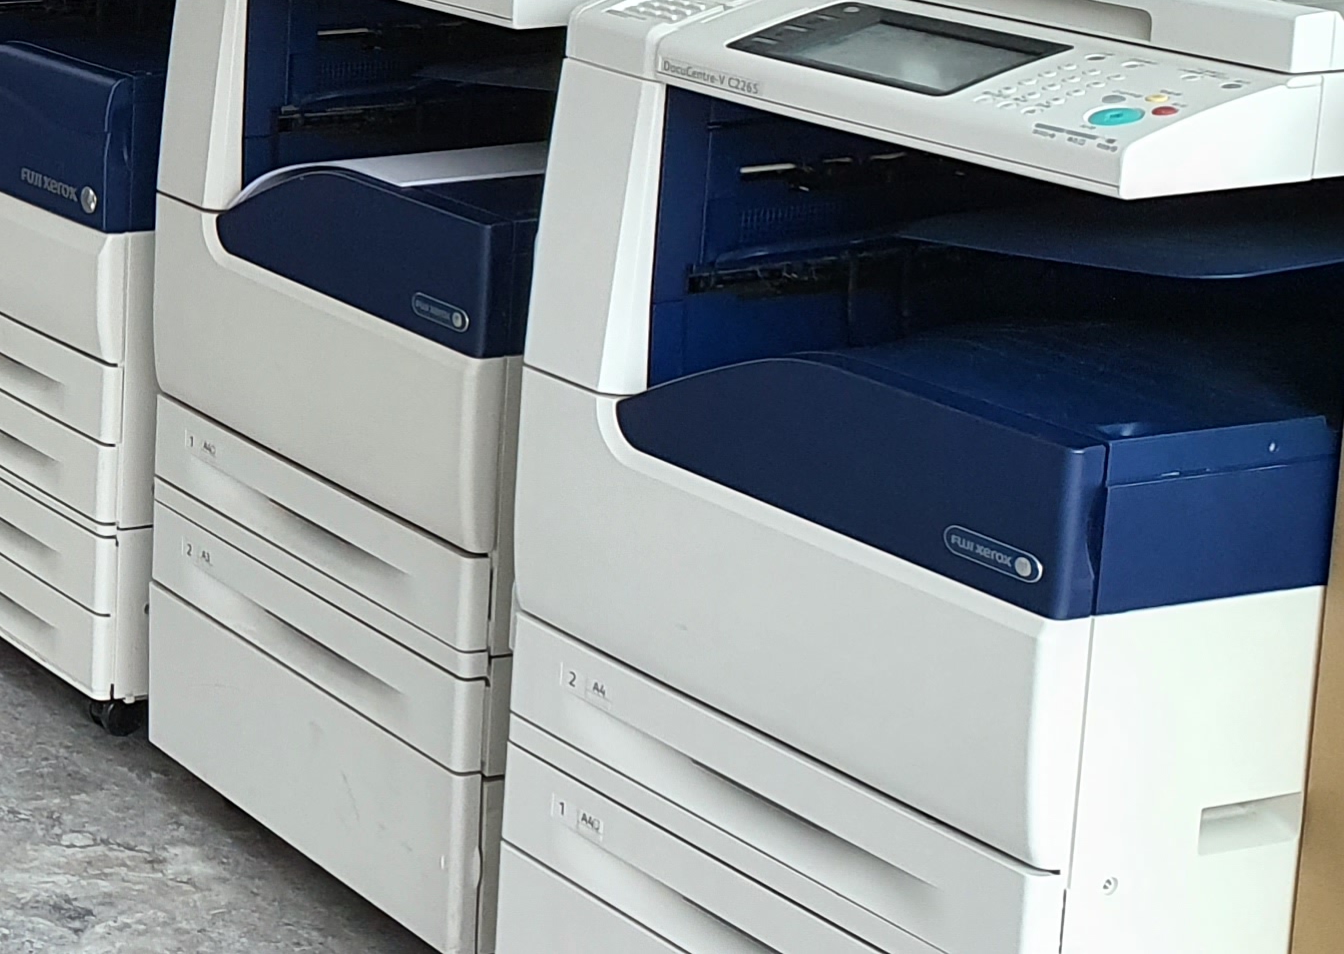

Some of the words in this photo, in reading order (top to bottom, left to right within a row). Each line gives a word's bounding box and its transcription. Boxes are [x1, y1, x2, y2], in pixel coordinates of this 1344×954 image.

[663, 60, 725, 85] DocuCentre-V
[728, 77, 758, 94] C2265
[21, 167, 42, 188] FUJI
[43, 176, 78, 202] xerox
[951, 534, 974, 551] FUJI
[975, 544, 1012, 568] xerox
[568, 671, 577, 687] 2
[592, 682, 606, 697] A4
